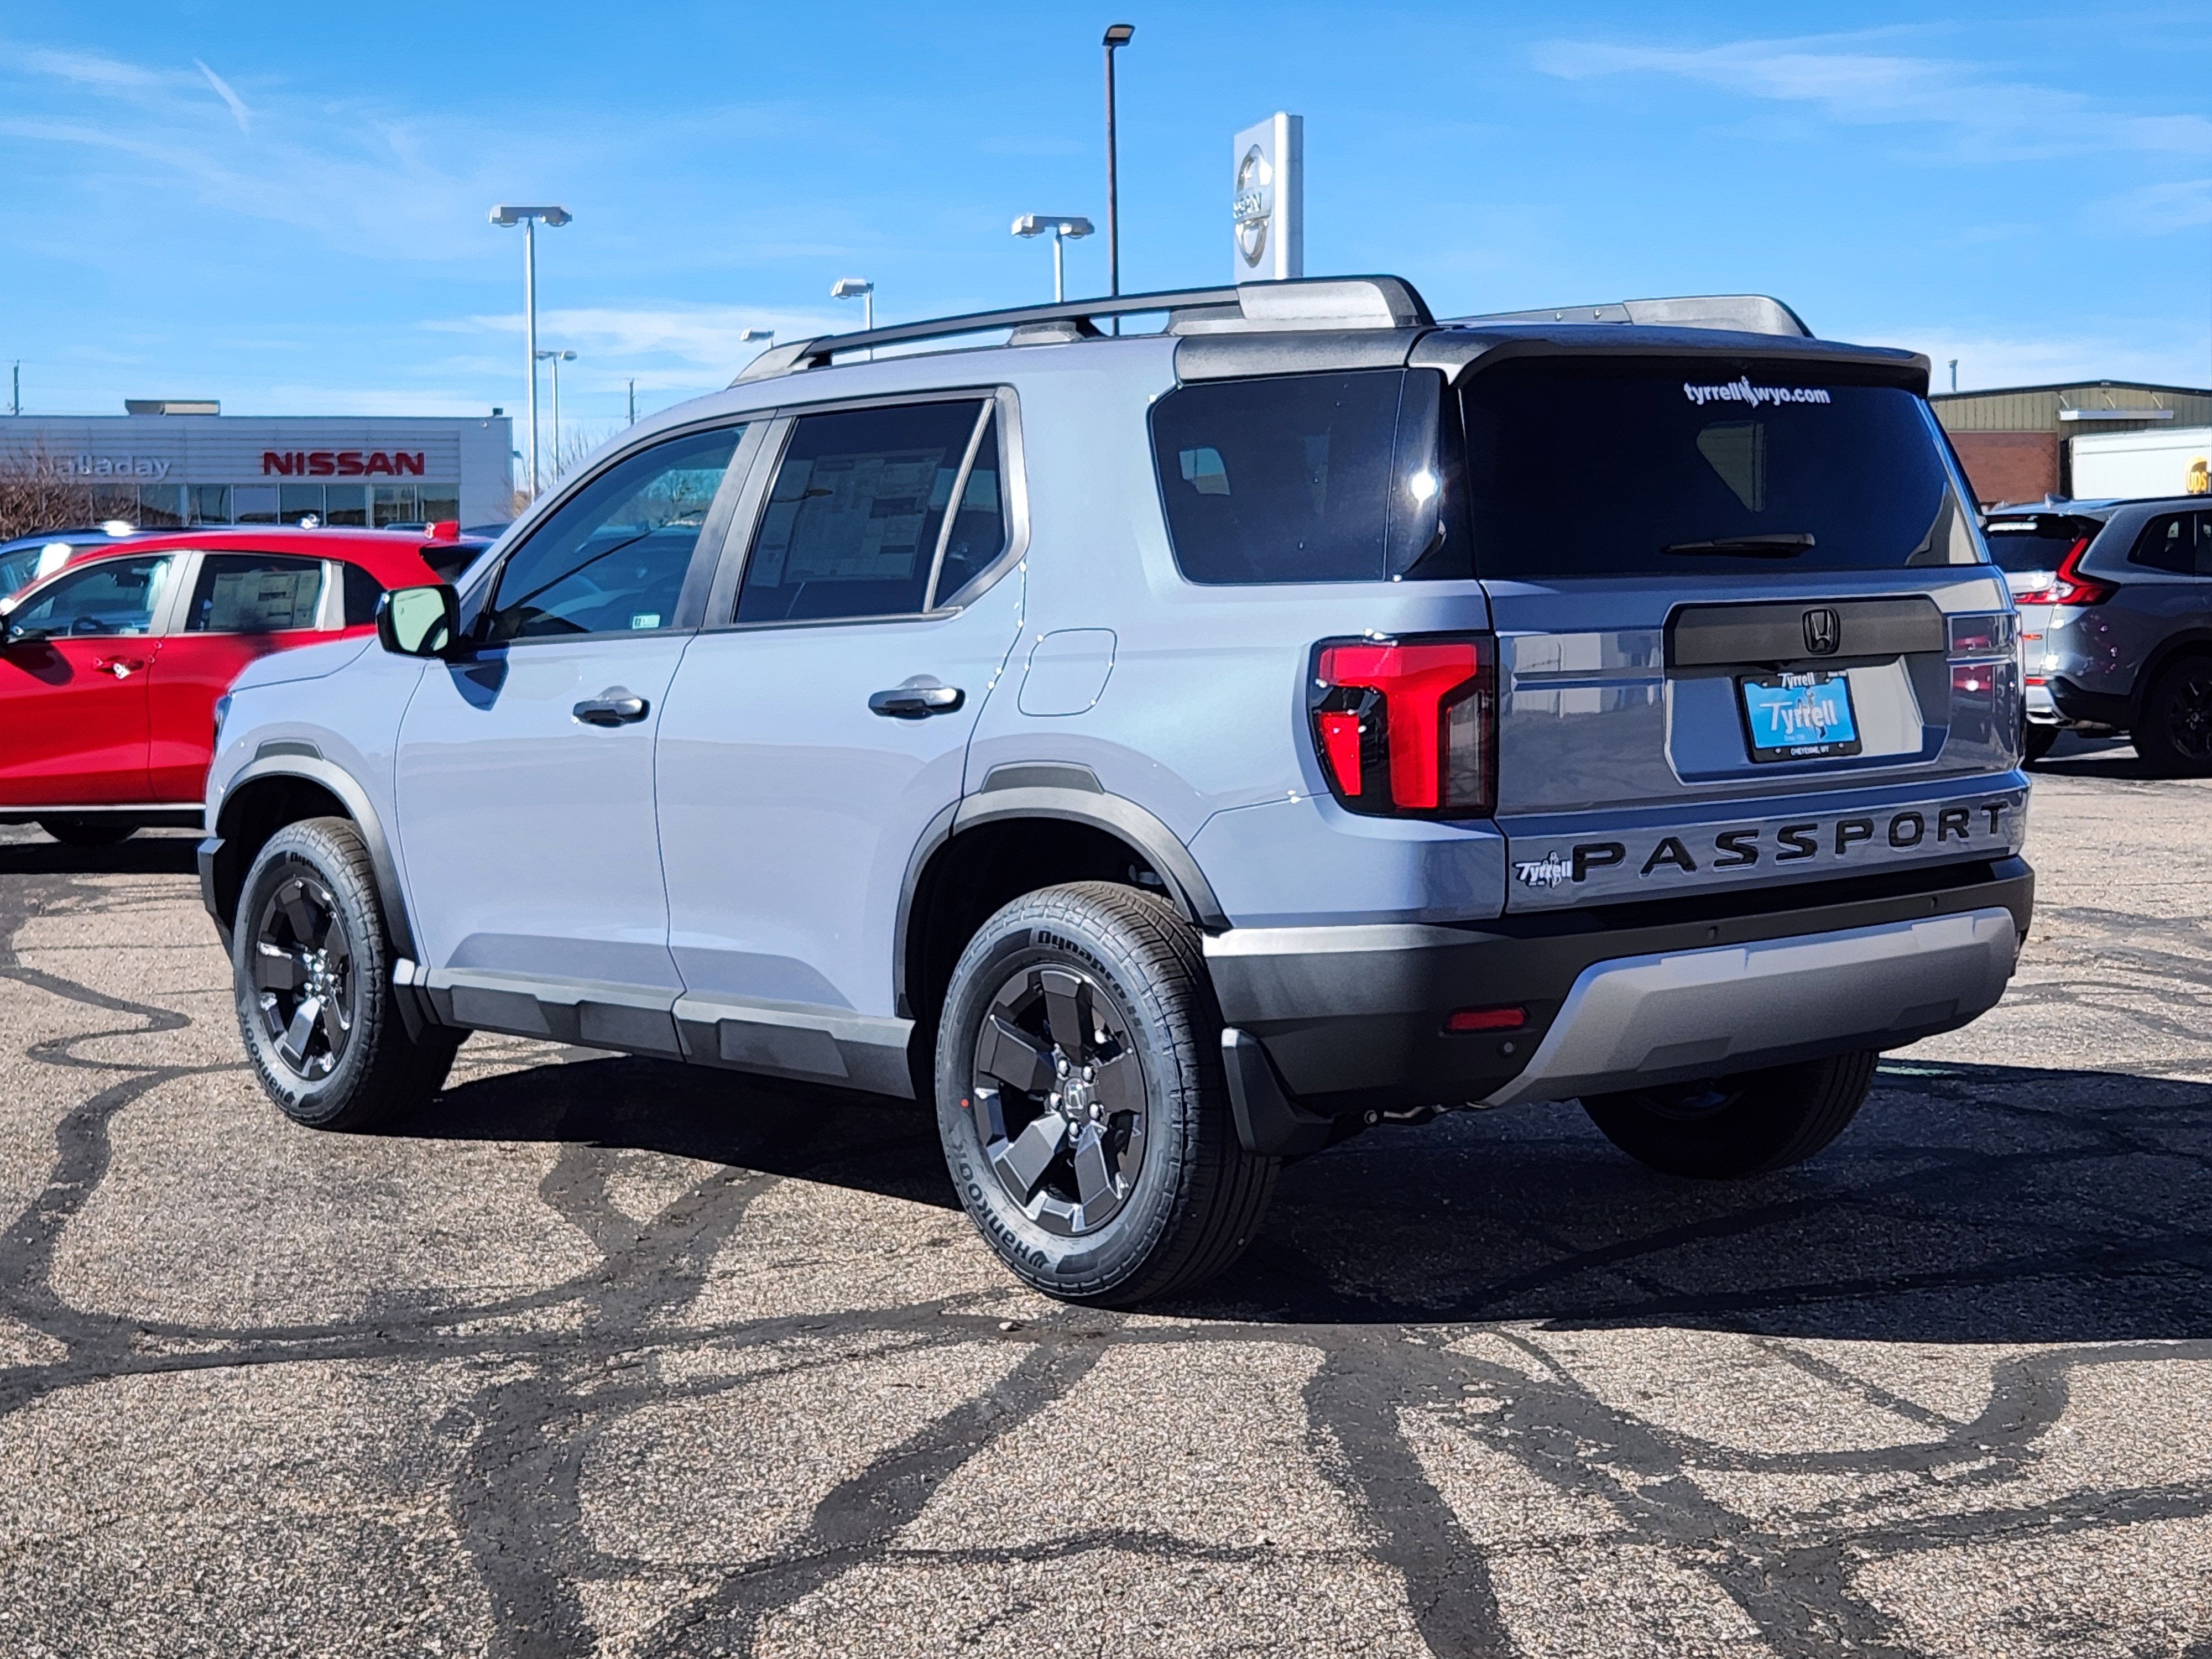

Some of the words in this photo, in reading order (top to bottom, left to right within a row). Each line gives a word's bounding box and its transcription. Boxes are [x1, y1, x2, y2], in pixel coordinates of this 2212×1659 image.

[30, 455, 171, 482] alladay
[263, 451, 425, 476] NISSAN
[1777, 671, 1815, 690] Tyrrell
[1759, 700, 1838, 735] Tyrrell
[1571, 802, 2010, 883] PASSPORT
[1037, 930, 1126, 999] Dynapro
